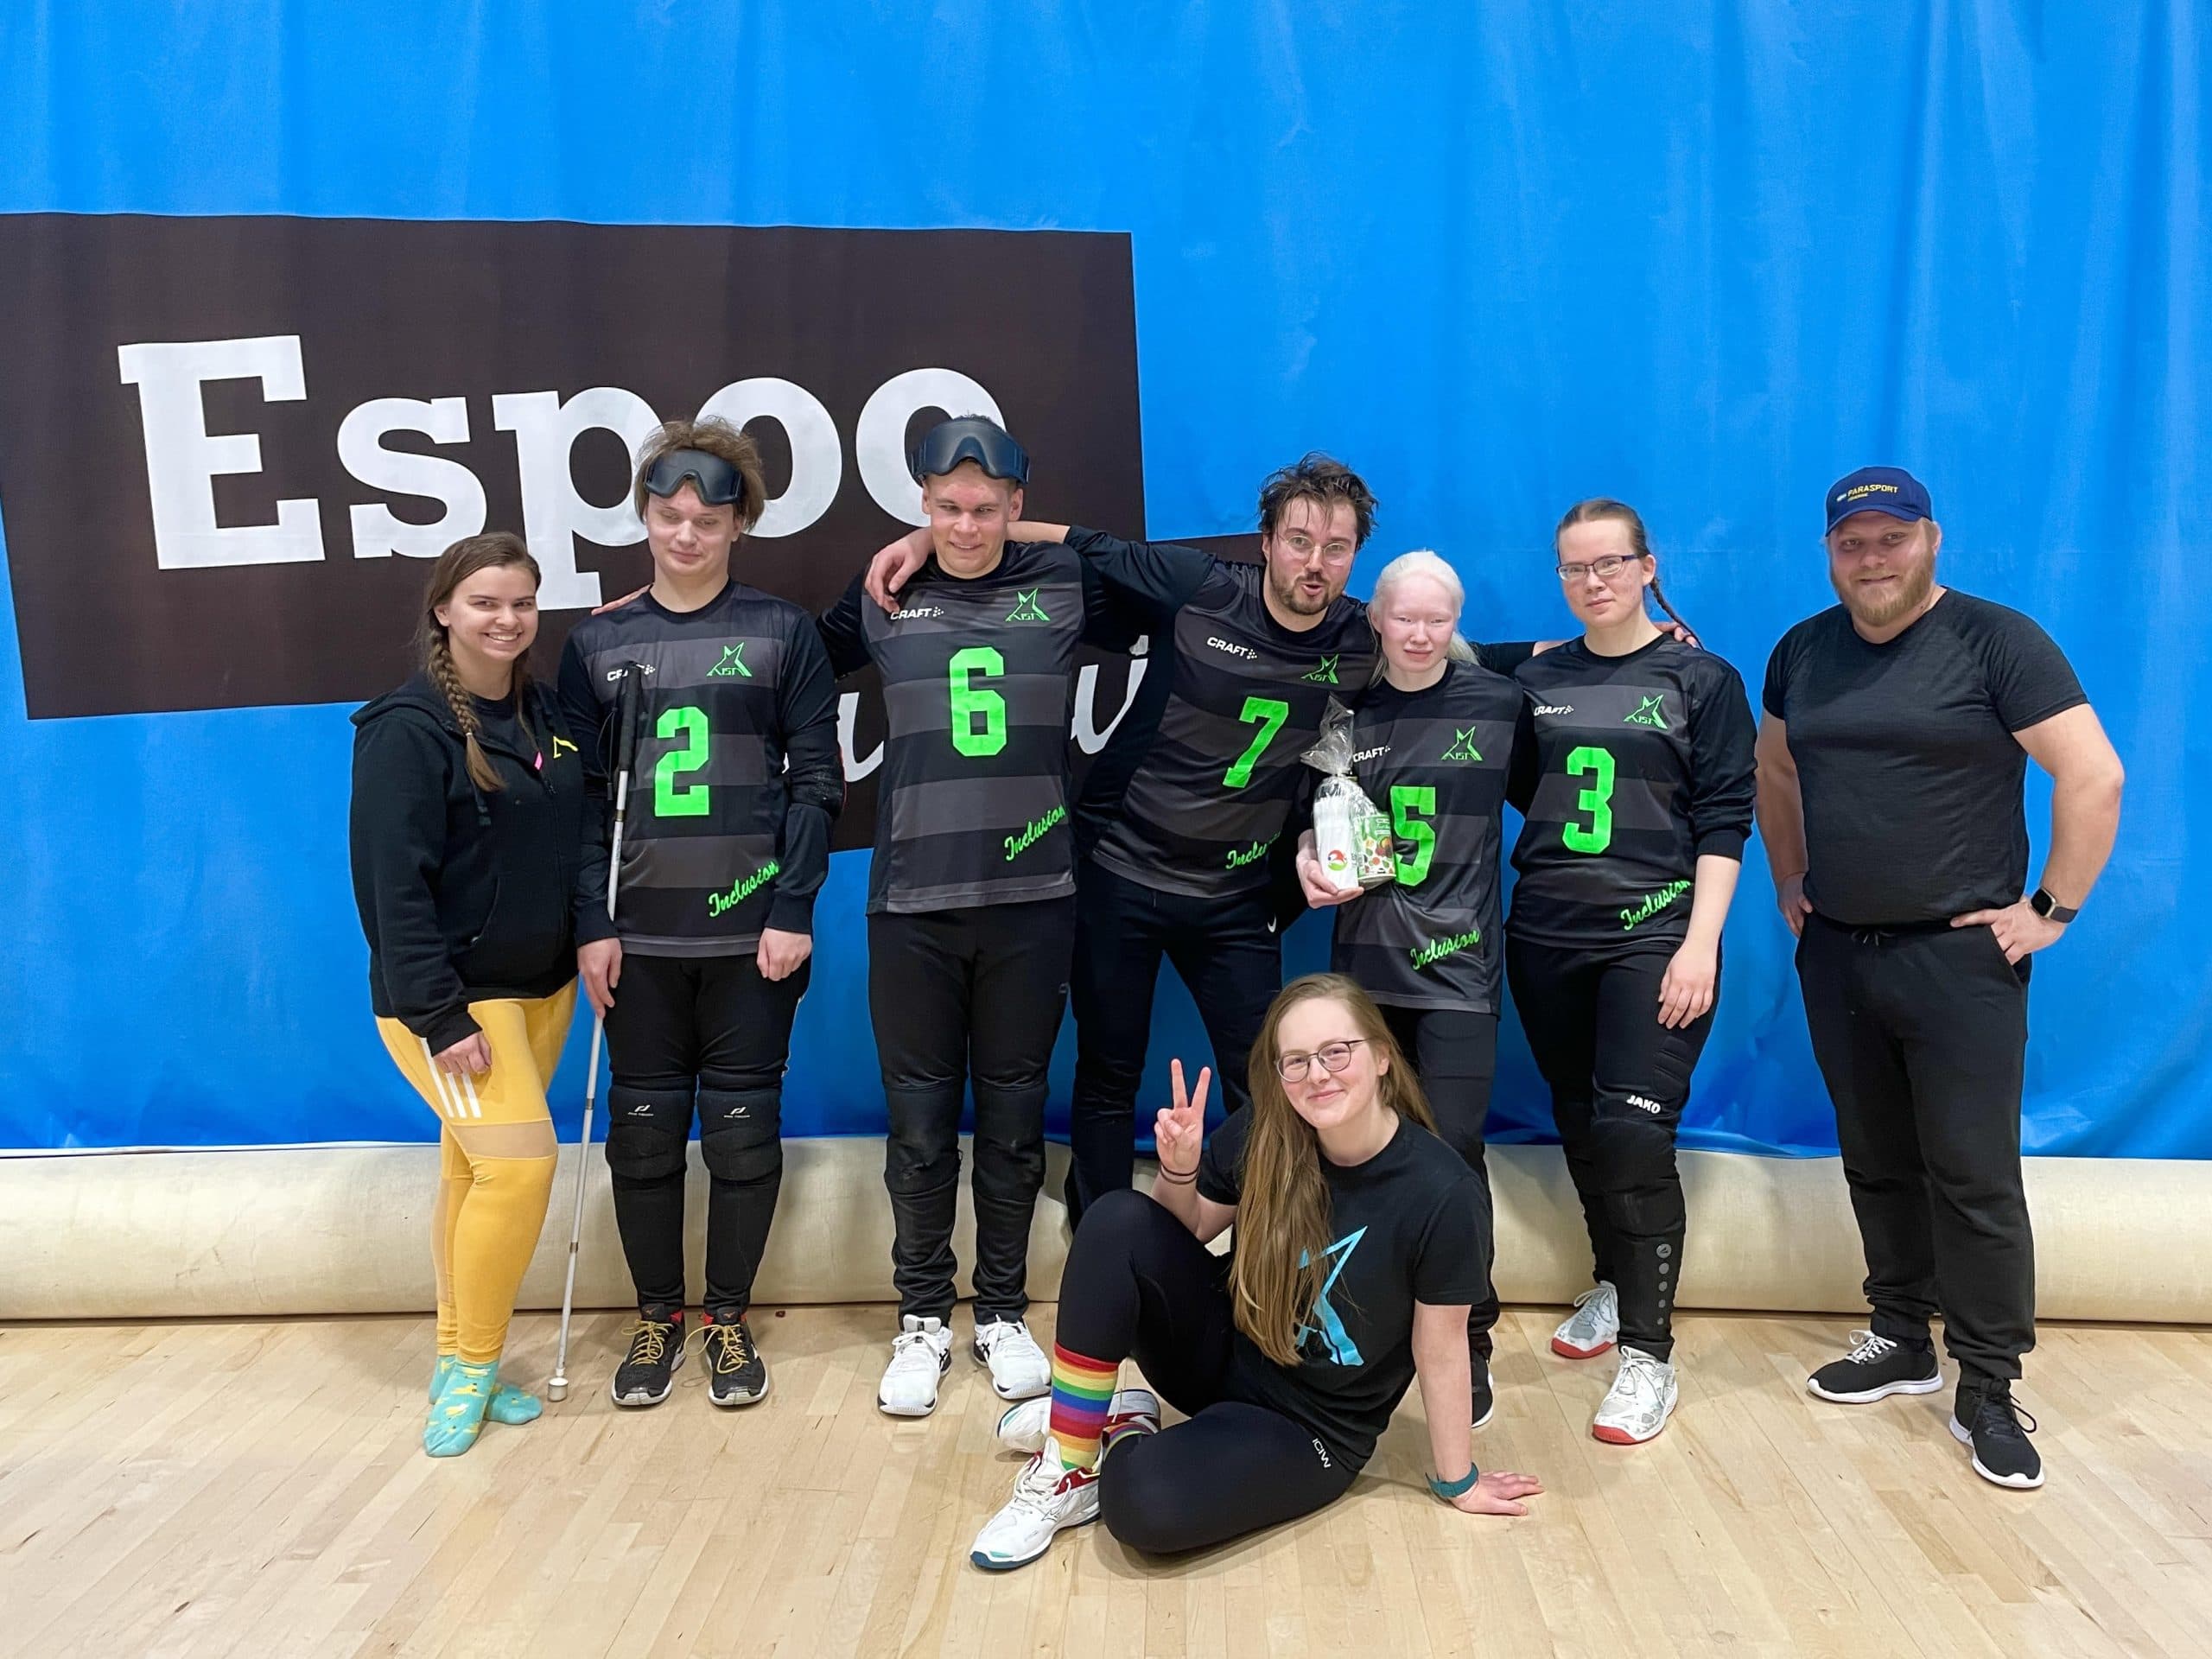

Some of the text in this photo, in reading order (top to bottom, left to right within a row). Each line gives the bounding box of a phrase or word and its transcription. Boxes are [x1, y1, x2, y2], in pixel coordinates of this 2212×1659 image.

[118, 334, 1007, 611] Espoo
[1847, 484, 1899, 498] PARASPORT
[890, 607, 932, 620] CRAFT
[1206, 636, 1249, 658] CRAFT
[950, 646, 1007, 757] 6
[1534, 705, 1567, 716] CRAFT
[654, 706, 710, 817] 2
[1223, 696, 1288, 788] 7
[1352, 747, 1385, 763] CRAFT
[1562, 746, 1615, 854] 3
[1004, 804, 1066, 861] Inclusion
[1390, 786, 1436, 887] 5
[709, 861, 779, 918] Inclusion
[1620, 880, 1691, 931] Inclusion
[1409, 929, 1480, 970] Inclusion
[1626, 1095, 1661, 1114] JAKO
